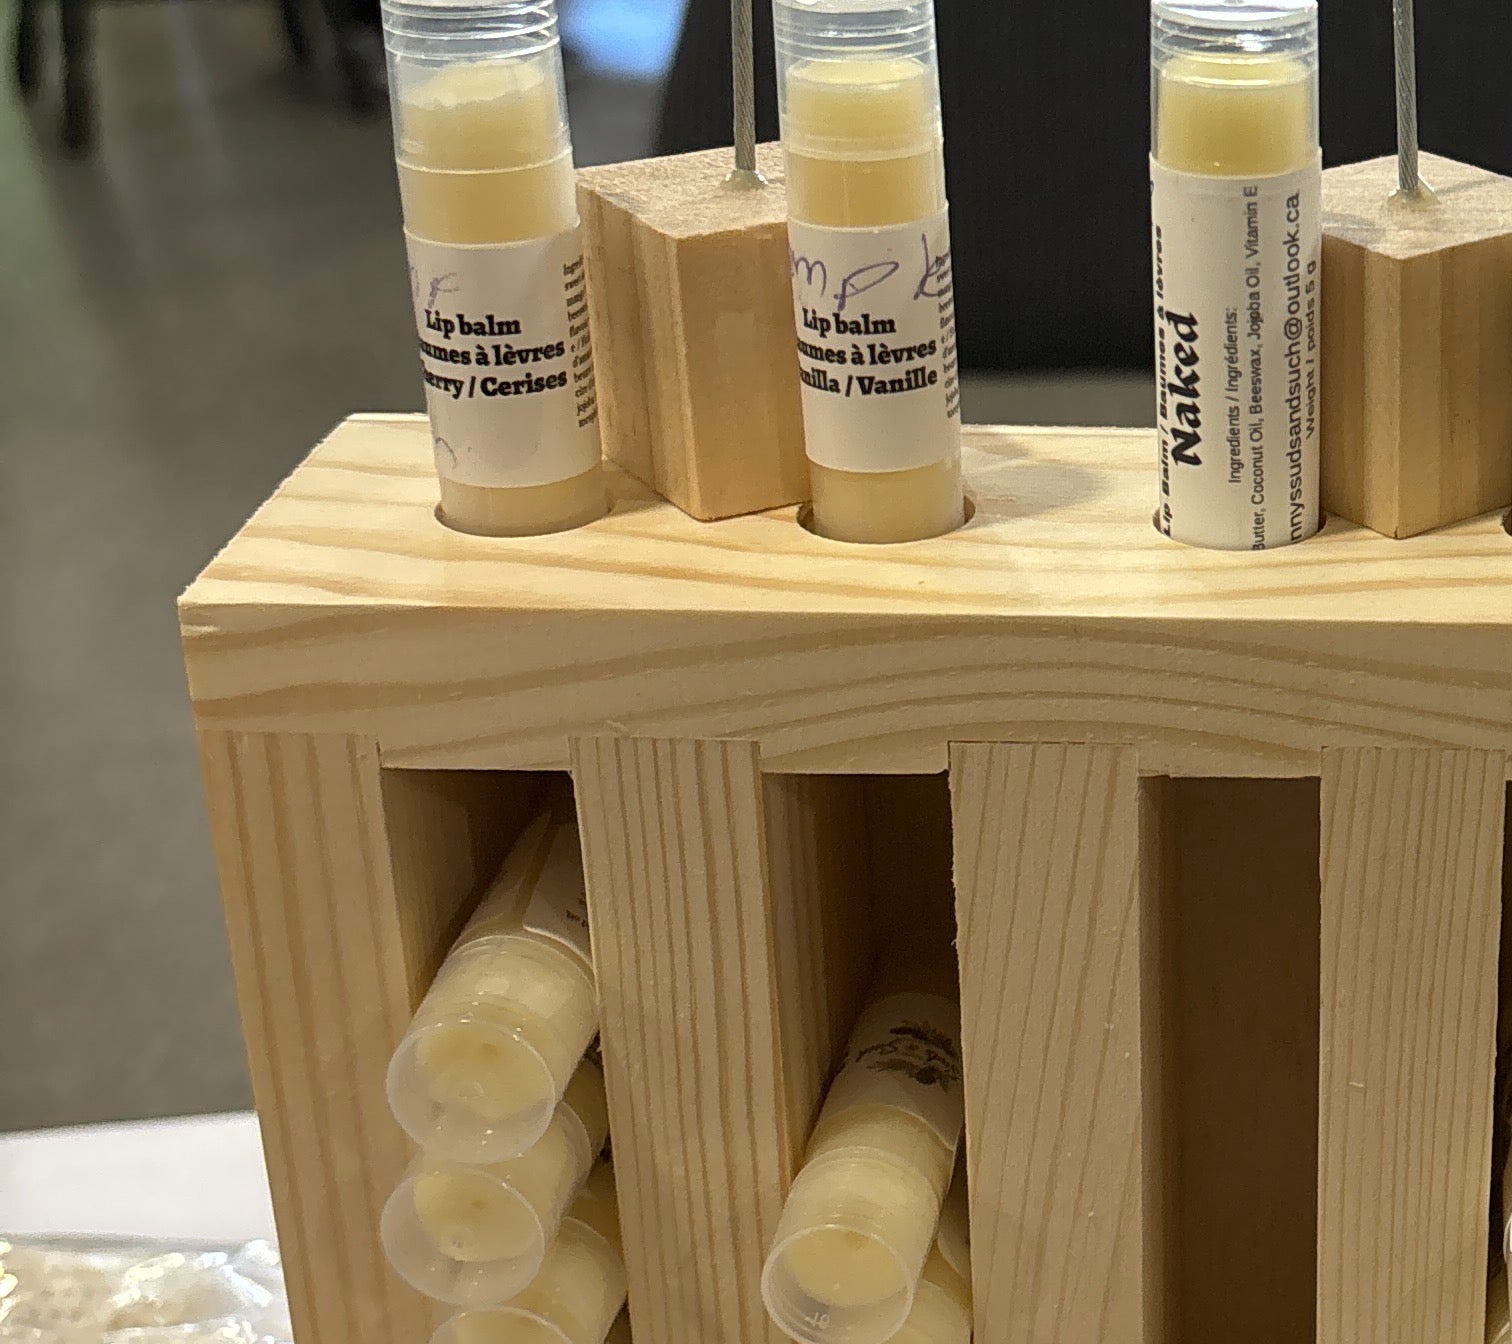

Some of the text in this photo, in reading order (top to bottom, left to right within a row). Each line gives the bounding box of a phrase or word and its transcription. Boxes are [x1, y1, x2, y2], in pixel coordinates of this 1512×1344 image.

[1244, 186, 1258, 197] E
[1244, 201, 1259, 258] Vitamin
[1245, 262, 1261, 288] Oil,
[1307, 260, 1317, 274] g
[1305, 280, 1315, 294] 5
[425, 309, 521, 340] Lip balm
[802, 308, 896, 338] Lip balm
[1247, 291, 1264, 340] Jojoba
[1305, 297, 1316, 352] poids
[476, 344, 490, 366] à
[492, 341, 565, 366] lèvres
[851, 343, 865, 365] à
[867, 340, 937, 365] lèvres
[1224, 307, 1242, 392] Ingrédients:
[468, 376, 476, 398] /
[480, 371, 567, 397] Cerises
[845, 374, 853, 397] /
[856, 366, 938, 396] Vanille
[1158, 326, 1168, 420] Baumes
[1164, 310, 1202, 466] Naked
[1248, 344, 1263, 414] Beeswax,
[1305, 368, 1316, 439] Weight
[1160, 424, 1168, 435] /
[1226, 406, 1244, 483] Ingredients
[1249, 418, 1264, 442] Oil,
[1161, 439, 1170, 496] Balm
[1250, 445, 1264, 505] Coconut
[1162, 503, 1173, 537] Lip
